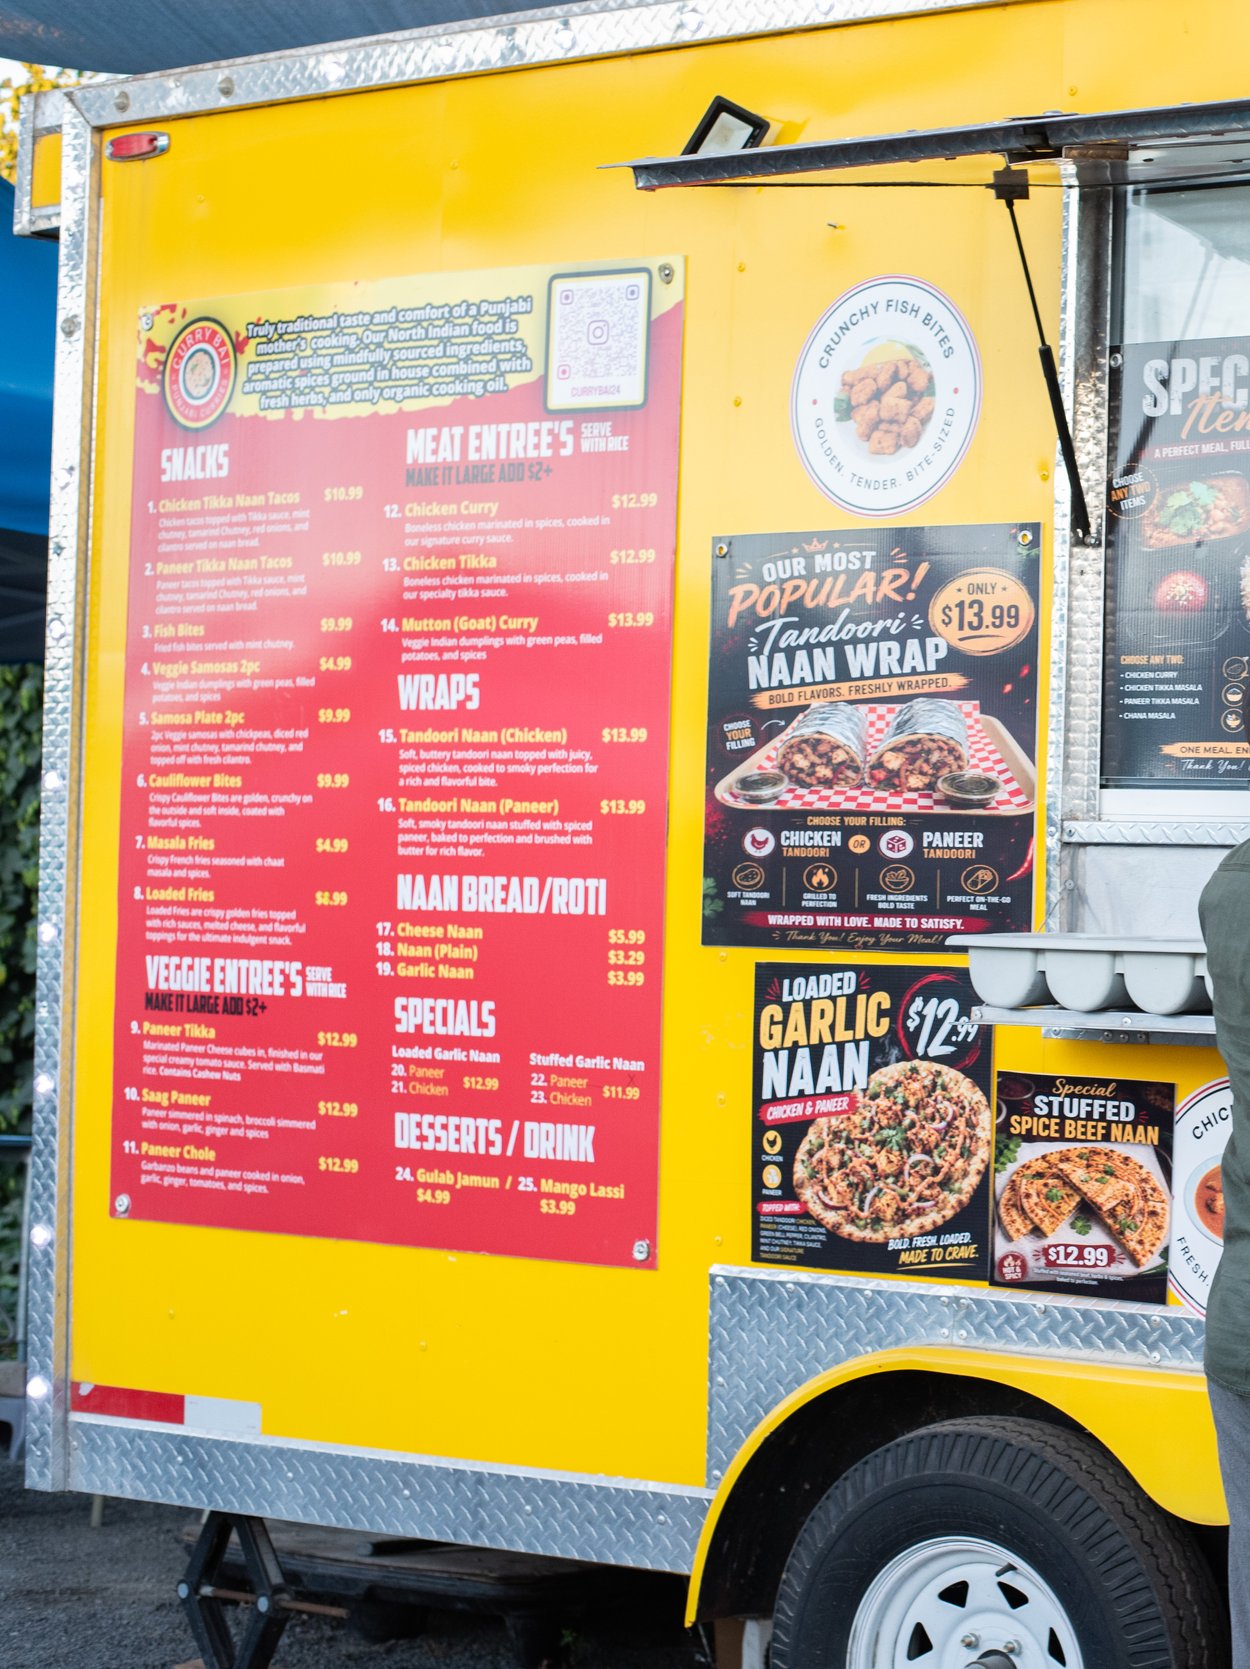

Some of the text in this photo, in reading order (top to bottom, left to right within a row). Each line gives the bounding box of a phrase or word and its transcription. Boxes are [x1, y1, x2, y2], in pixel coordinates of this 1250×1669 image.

[247, 297, 532, 339] Truly traditional taste and comfort of a Punjabi
[818, 299, 954, 369] CRUNCHY FISH BITES
[172, 327, 230, 369] CURRY BAI
[581, 422, 612, 437] SERVE
[407, 420, 574, 464] MEAT ENTREE'S
[581, 436, 629, 452] WITH RICE
[906, 407, 955, 482] BITE-SIZED
[1154, 448, 1161, 459] A
[1162, 444, 1201, 457] PERFECT
[1202, 441, 1229, 454] MEAL,
[161, 444, 229, 482] SNACKS
[1113, 472, 1144, 488] CHOOSE
[1110, 481, 1151, 501] ANY TWO
[384, 493, 658, 518] 12. Chicken Curry $12.99
[1120, 496, 1146, 510] ITEMS
[762, 550, 876, 583] OUR MOST
[727, 561, 931, 629] POPULAR!
[967, 582, 997, 596] ONLY
[941, 599, 1020, 632] $13.99
[754, 607, 906, 656] Tandoori
[748, 637, 948, 690] NAAN WRAP
[1155, 671, 1178, 679] CURRY
[397, 674, 480, 711] WRAPS
[769, 676, 951, 705] BOLD FLAVORS. FRESHLY WRAPPED.
[723, 720, 751, 732] CHOOSE
[1148, 712, 1176, 720] MASALA
[378, 727, 647, 745] 15. Tandoori Naan (Chicken) $13.99
[725, 729, 752, 741] YOUR
[726, 738, 755, 751] FILLING
[399, 749, 418, 760] Soft,
[420, 750, 451, 762] buttery
[452, 749, 489, 760] tandoori
[491, 751, 513, 760] naan
[515, 749, 547, 762] topped
[548, 749, 568, 760] with
[1180, 746, 1200, 754] ONE
[1181, 759, 1213, 771] Thank
[1217, 760, 1244, 773] You!
[807, 816, 907, 827] CHOOSE YOUR FILLING:
[780, 831, 842, 847] CHICKEN
[853, 839, 866, 849] OR
[923, 832, 984, 848] PANEER
[782, 847, 830, 858] TANDOORI
[923, 848, 976, 860] TANDOORI
[397, 874, 607, 916] NAAN BREAD/ROTI
[946, 895, 1012, 905] PERFECT ON-THE-GO
[969, 903, 988, 912] MEAL
[767, 914, 965, 930] WRAPPED WITH LOVE. MADE TO SATISFY.
[376, 922, 645, 944] 17. Cheese Naan $5.99
[785, 930, 943, 946] Thank You! Enjoy Your Meal!
[145, 955, 302, 997] VEGGIE ENTREE'S
[782, 971, 857, 1003] LOADED
[145, 992, 267, 1017] MAKE IT LARGE ADD $2+
[394, 996, 496, 1037] SPECIALS
[759, 991, 979, 1057] GARLIC $12.99
[761, 1041, 870, 1100] NAAN
[1052, 1078, 1117, 1098] Special
[767, 1097, 849, 1120] CHICKEN & PANEER
[1034, 1095, 1136, 1122] STUFFED
[1010, 1115, 1159, 1145] SPICE BEEF NAAN
[1192, 1104, 1233, 1139] CHIC
[394, 1112, 502, 1156] DESSERTS
[524, 1121, 595, 1163] DRINK
[395, 1166, 414, 1181] 24.
[416, 1168, 455, 1185] Gulab
[455, 1172, 500, 1190] Jamun
[517, 1177, 537, 1192] 25.
[540, 1179, 587, 1199] Mango
[589, 1183, 625, 1199] Lassi
[416, 1188, 576, 1215] $4.99 $3.99
[888, 1232, 972, 1251] BOLD. FRESH. LOADED.
[899, 1245, 979, 1264] MADE TO CRAVE.
[1048, 1246, 1108, 1266] $12.99
